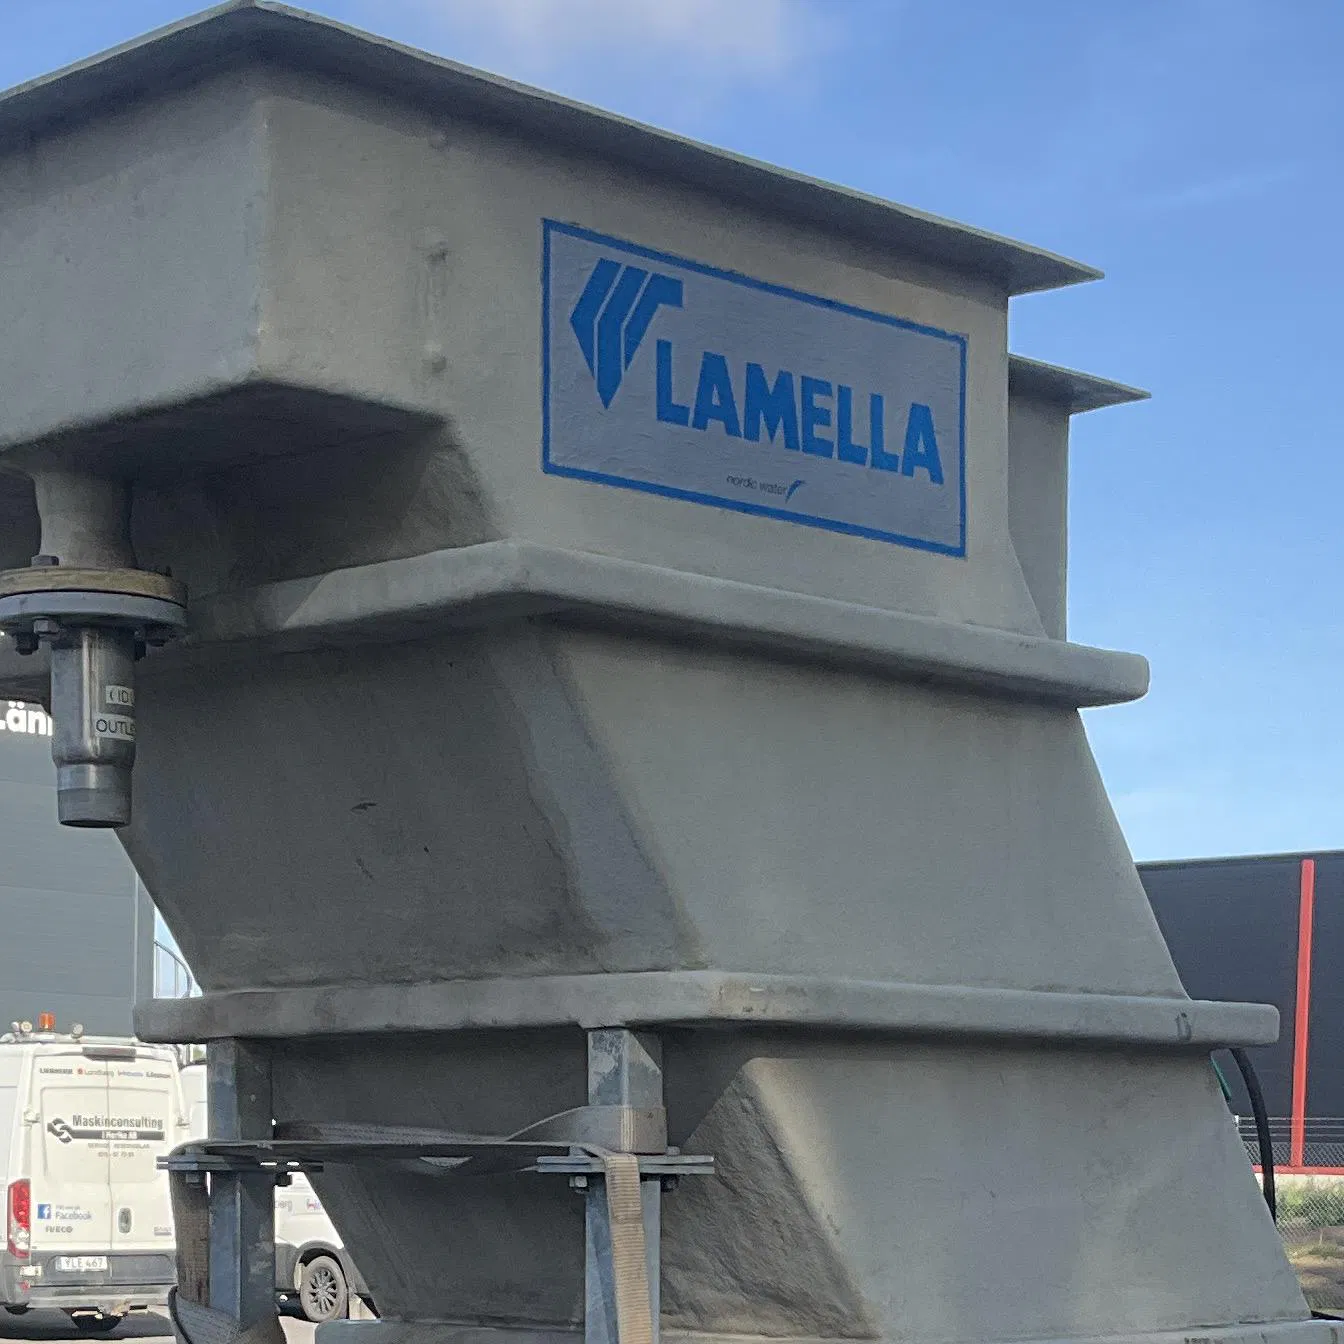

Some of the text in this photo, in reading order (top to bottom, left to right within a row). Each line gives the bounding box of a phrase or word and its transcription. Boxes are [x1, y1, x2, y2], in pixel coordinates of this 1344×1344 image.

[657, 339, 944, 485] LAMELLA
[726, 475, 788, 496] nordic water
[72, 1114, 164, 1130] Maskinconsulting
